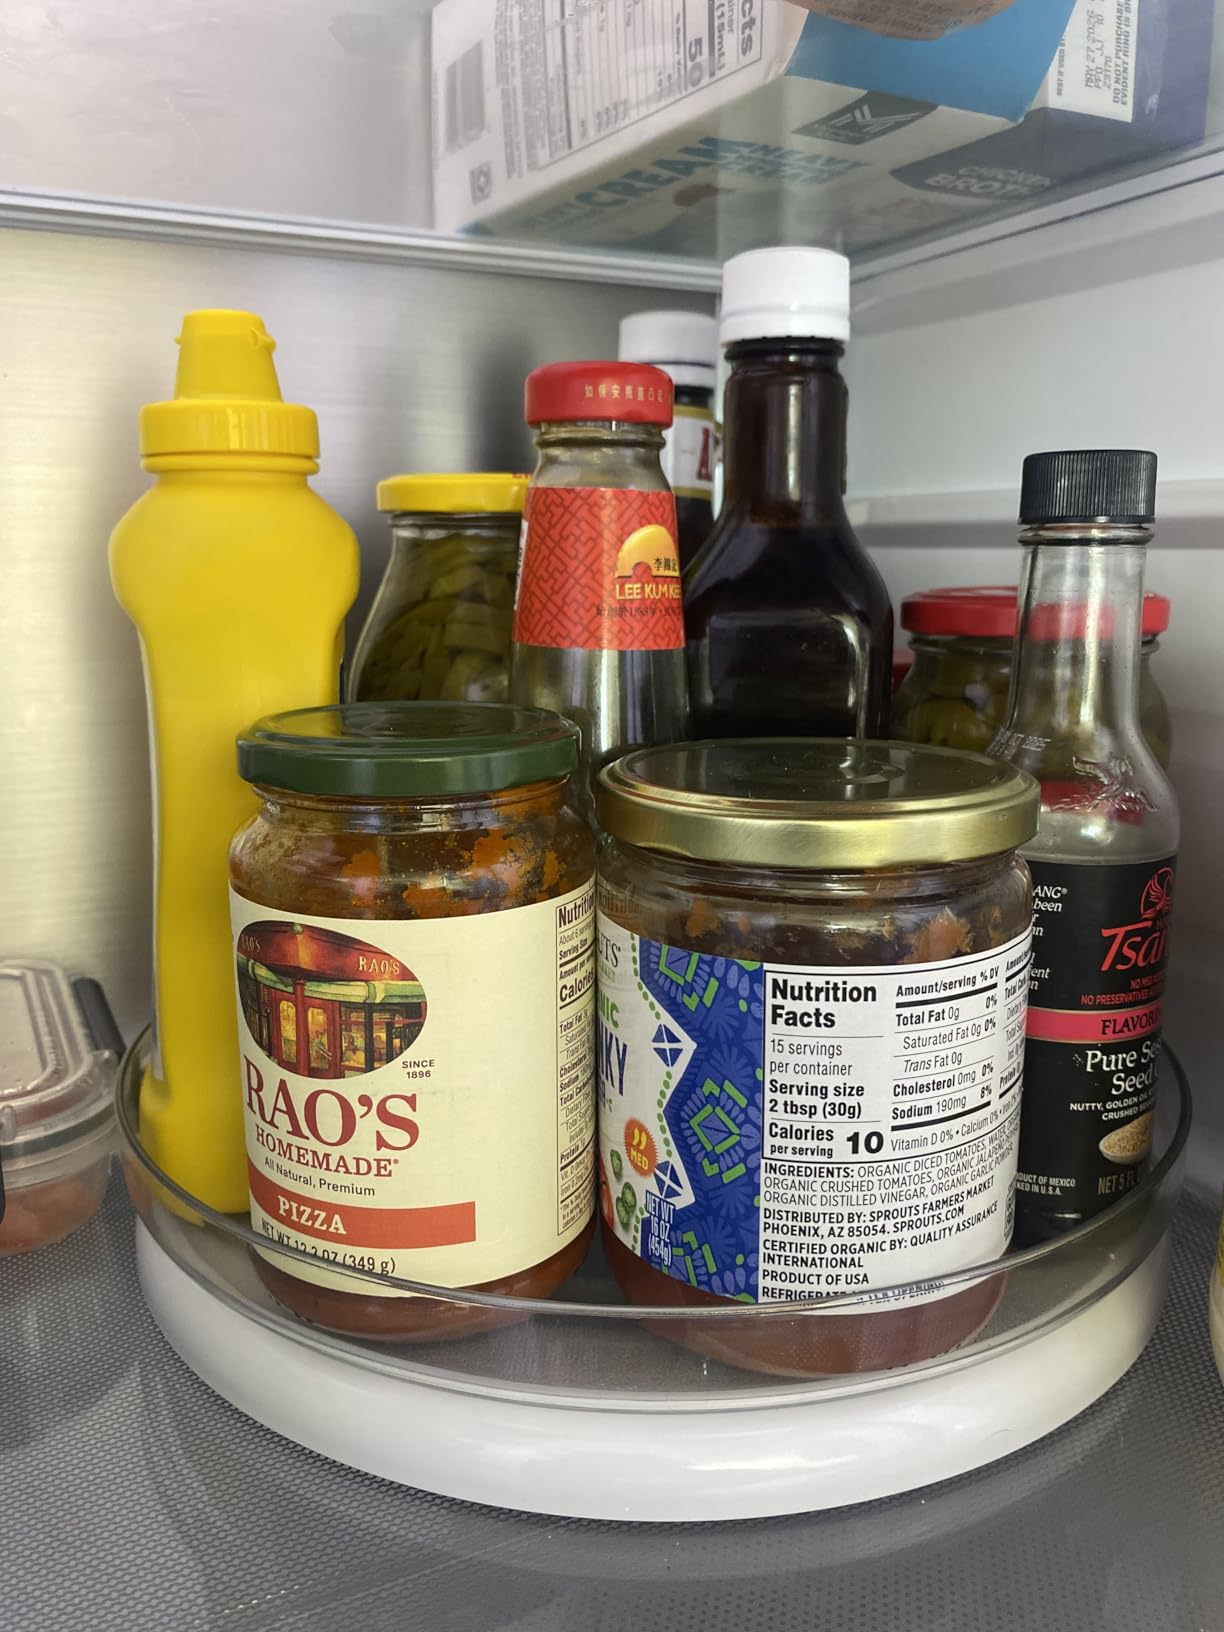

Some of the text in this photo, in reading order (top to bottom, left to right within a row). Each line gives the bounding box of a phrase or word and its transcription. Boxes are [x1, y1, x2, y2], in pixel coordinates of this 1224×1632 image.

[1085, 9, 1096, 88] MAY 27 2026
[1112, 0, 1124, 104] DO NOT PURCHASE
[1122, 30, 1131, 58] RING
[688, 37, 703, 88] 50
[1120, 60, 1129, 106] EVIDENT
[616, 583, 668, 600] LEE KUM
[1033, 899, 1062, 912] been
[559, 943, 579, 960] Serving
[358, 955, 400, 975] RAO'S
[559, 967, 594, 1002] Calories
[771, 978, 877, 1003] Nutrition
[896, 965, 999, 997] Amount/serving % DV
[1005, 981, 1018, 1000] Total
[896, 994, 997, 1027] Total Fat 0g 0%
[1080, 993, 1094, 1006] NO
[559, 1018, 574, 1034] Total
[771, 1004, 836, 1028] Facts
[903, 1017, 996, 1050] Saturated Fat 0g 0%
[770, 1039, 843, 1059] 15 servings
[402, 1059, 435, 1069] SINCE
[769, 1061, 853, 1076] per container
[903, 1051, 963, 1073] Trans Fat 0g
[1085, 1050, 1137, 1073] Pure
[406, 1070, 432, 1079] 1896
[559, 1073, 580, 1093] Sodium
[893, 1061, 993, 1097] Cholesterol 0mg 0%
[1000, 1066, 1015, 1088] Protein
[559, 1090, 575, 1107] Total
[769, 1079, 865, 1099] Serving size
[243, 1054, 420, 1152] RAO'S
[769, 1098, 862, 1119] 2 tbsp (30g)
[891, 1084, 992, 1120] Sodium 190mg 8%
[1102, 1106, 1138, 1121] CRUSHED
[1106, 1095, 1138, 1110] GOLDEN
[769, 1122, 834, 1141] Calories
[891, 1136, 928, 1151] Vitamin
[931, 1133, 938, 1145] D
[939, 1128, 954, 1143] 0%
[961, 1116, 989, 1137] Calcium
[989, 1108, 998, 1123] 0%
[560, 1143, 580, 1165] Protein
[770, 1144, 833, 1158] per serving
[846, 1131, 884, 1155] 10
[630, 1147, 649, 1170] MED
[764, 1162, 854, 1178] INGREDIENTS:
[858, 1160, 911, 1178] ORGANIC
[914, 1155, 942, 1172] DICED
[944, 1139, 987, 1166] TOMATOES,
[264, 1156, 376, 1197] All Natural, Premium
[764, 1161, 973, 1193] ORGANIC CRUSHED TOMATOES, ORGANIC
[764, 1161, 994, 1207] ORGANIC DISTILLED VINEGAR, ORGANIC GARLIC
[1032, 1183, 1039, 1193] IN
[1038, 1175, 1076, 1188] OF MEXICO
[1098, 1176, 1117, 1195] NET
[1119, 1173, 1125, 1188] 5
[646, 1192, 675, 1224] NET WT
[764, 1175, 994, 1224] DISTRIBUTED BY: SPROUTS FARMERS MARKET
[277, 1195, 348, 1235] PIZZA
[763, 1204, 965, 1239] PHOENIX, AZ 85054. SPROUTS.COM
[262, 1217, 275, 1239] NET
[650, 1215, 670, 1242] 16 OZ
[763, 1200, 998, 1255] CERTIFIED ORGANIC BY: QUALITY ASSURANCE
[648, 1234, 672, 1267] (454g)
[762, 1252, 864, 1268] INTERNATIONAL
[762, 1269, 869, 1286] PRODUCT OF USA
